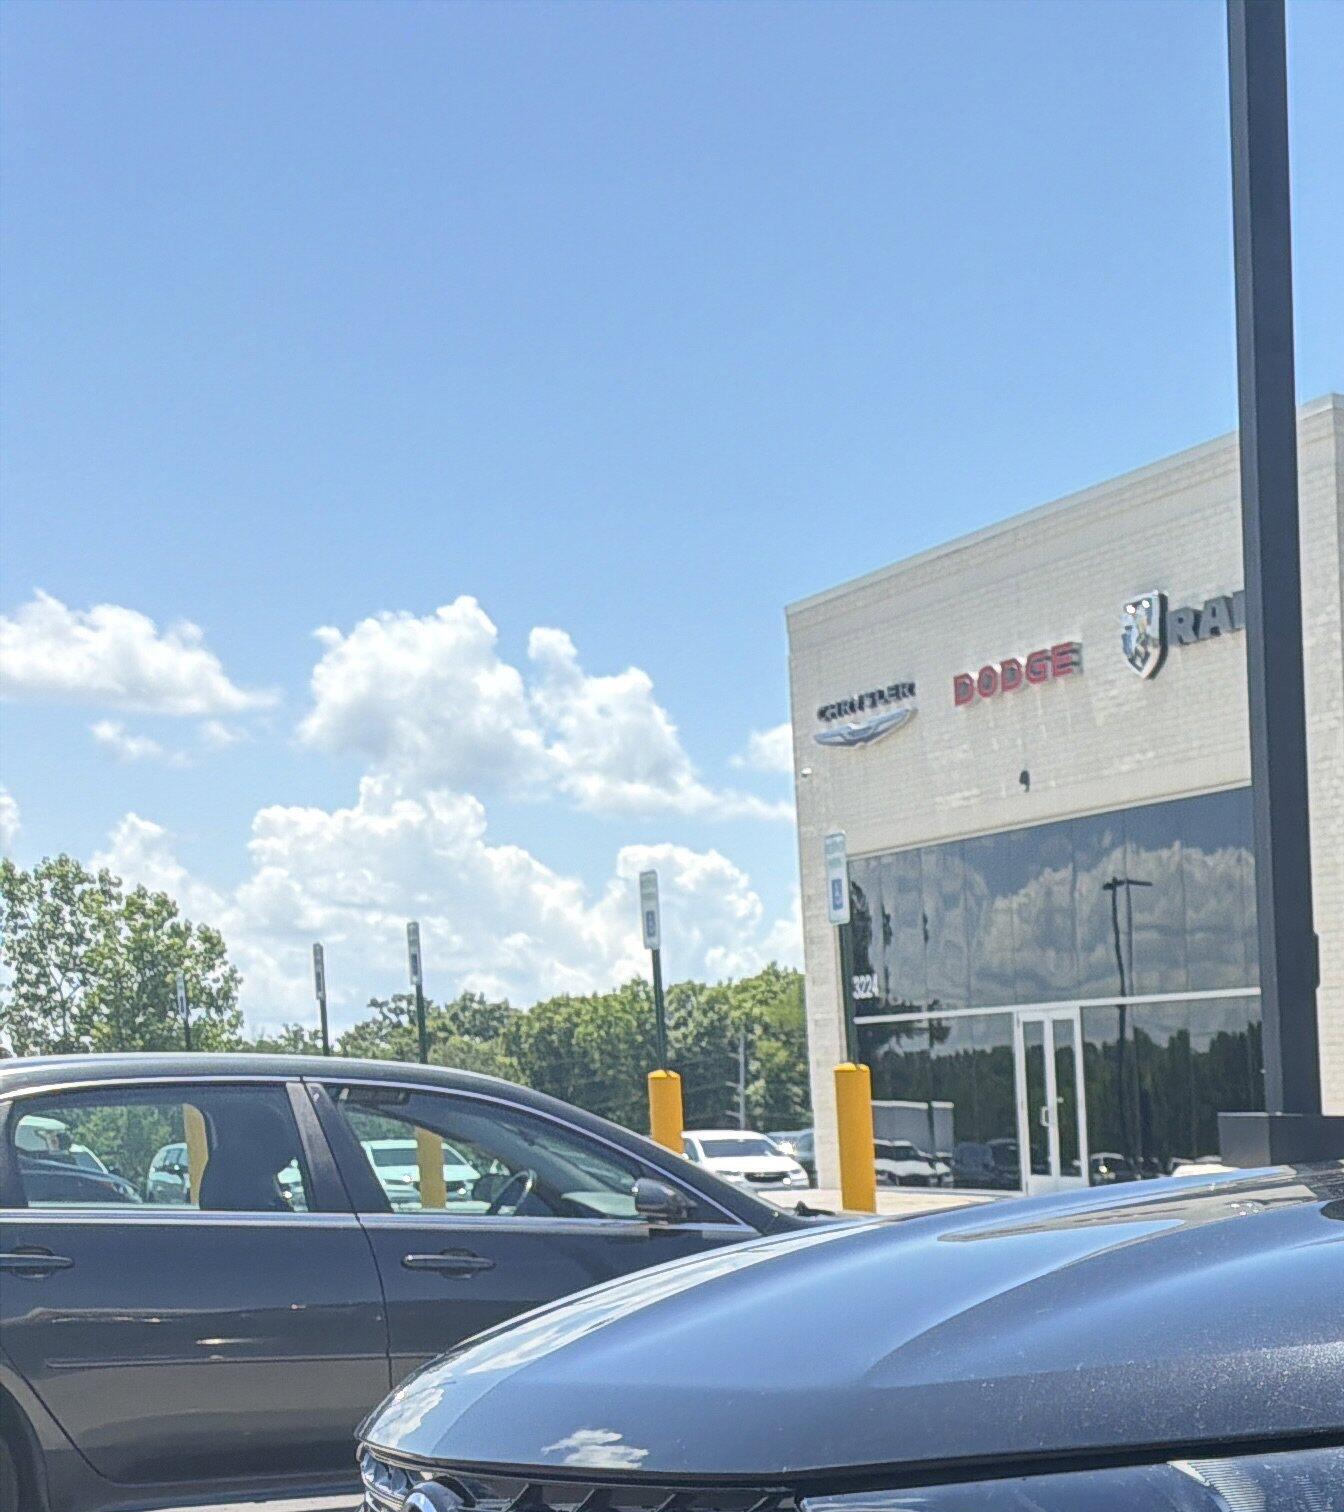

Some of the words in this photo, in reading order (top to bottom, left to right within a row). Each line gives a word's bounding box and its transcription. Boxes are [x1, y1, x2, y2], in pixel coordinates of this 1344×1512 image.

[1167, 590, 1246, 646] RA
[953, 642, 1082, 706] DODGE
[852, 974, 880, 1000] 3224
